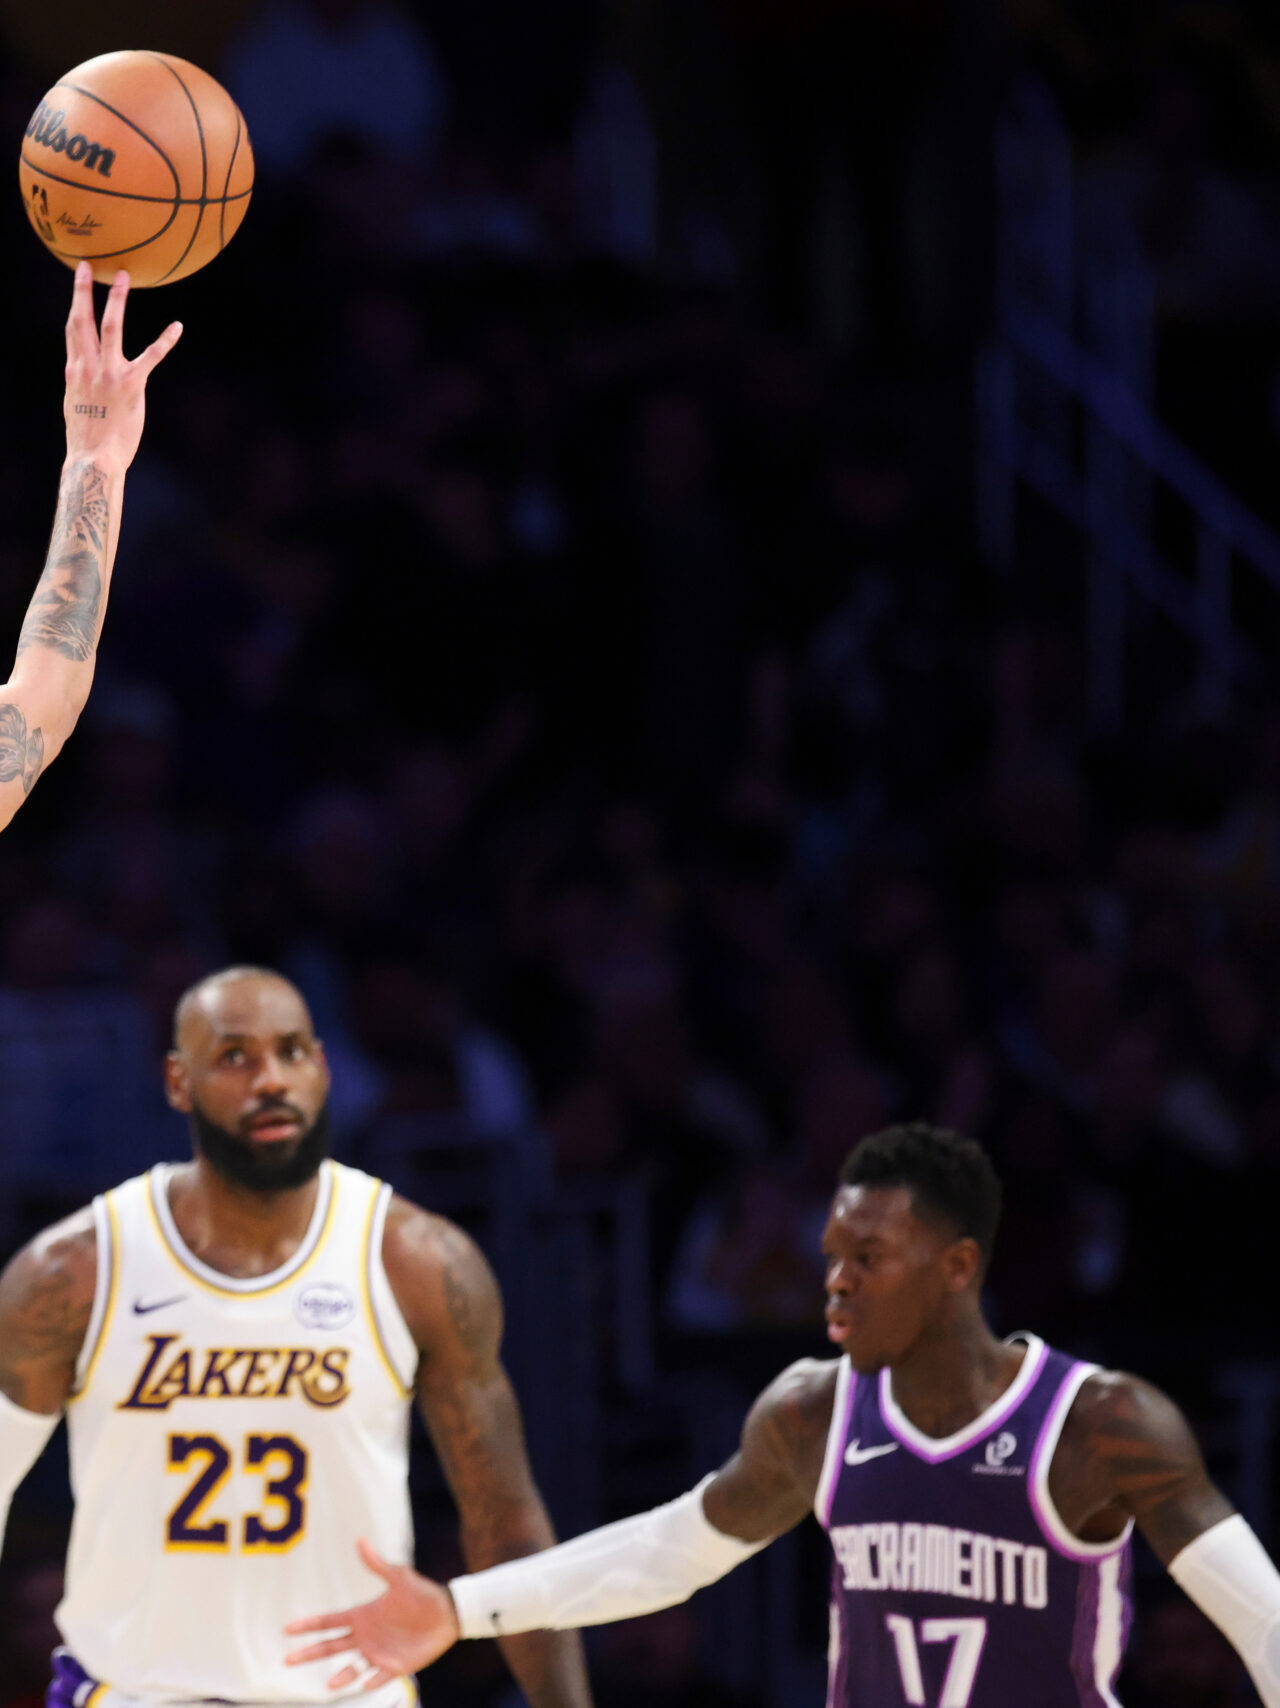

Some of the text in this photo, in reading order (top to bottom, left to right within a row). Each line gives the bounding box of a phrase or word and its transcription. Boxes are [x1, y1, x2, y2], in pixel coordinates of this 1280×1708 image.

[116, 1334, 351, 1412] LAKERS
[164, 1432, 309, 1554] 23
[886, 1613, 987, 1708] 17
